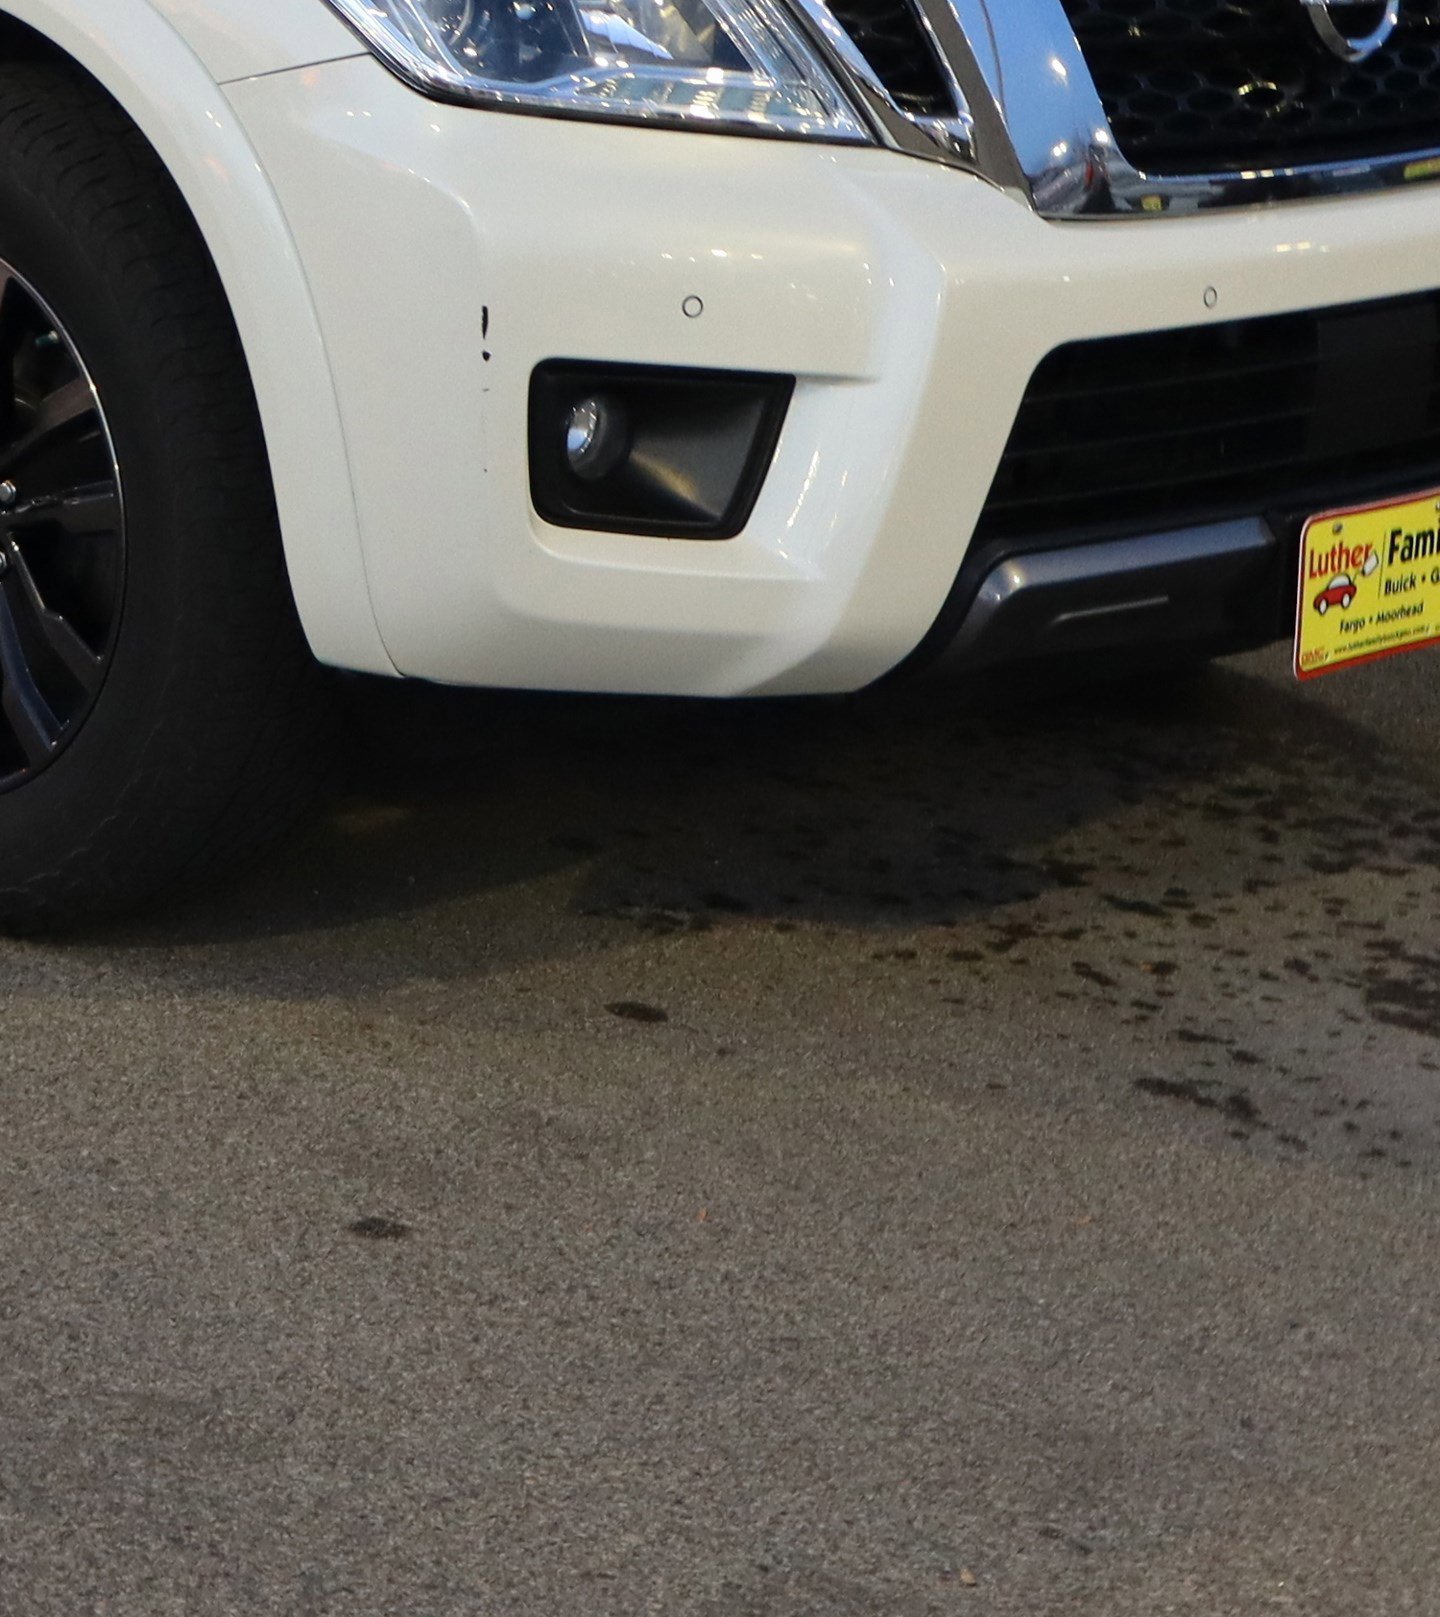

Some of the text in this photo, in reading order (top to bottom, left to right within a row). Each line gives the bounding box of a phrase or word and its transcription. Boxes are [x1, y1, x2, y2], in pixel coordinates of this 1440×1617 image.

[1309, 538, 1373, 580] Luther
[1383, 573, 1417, 596] Buick
[1339, 601, 1424, 634] Fargo Moorhead
